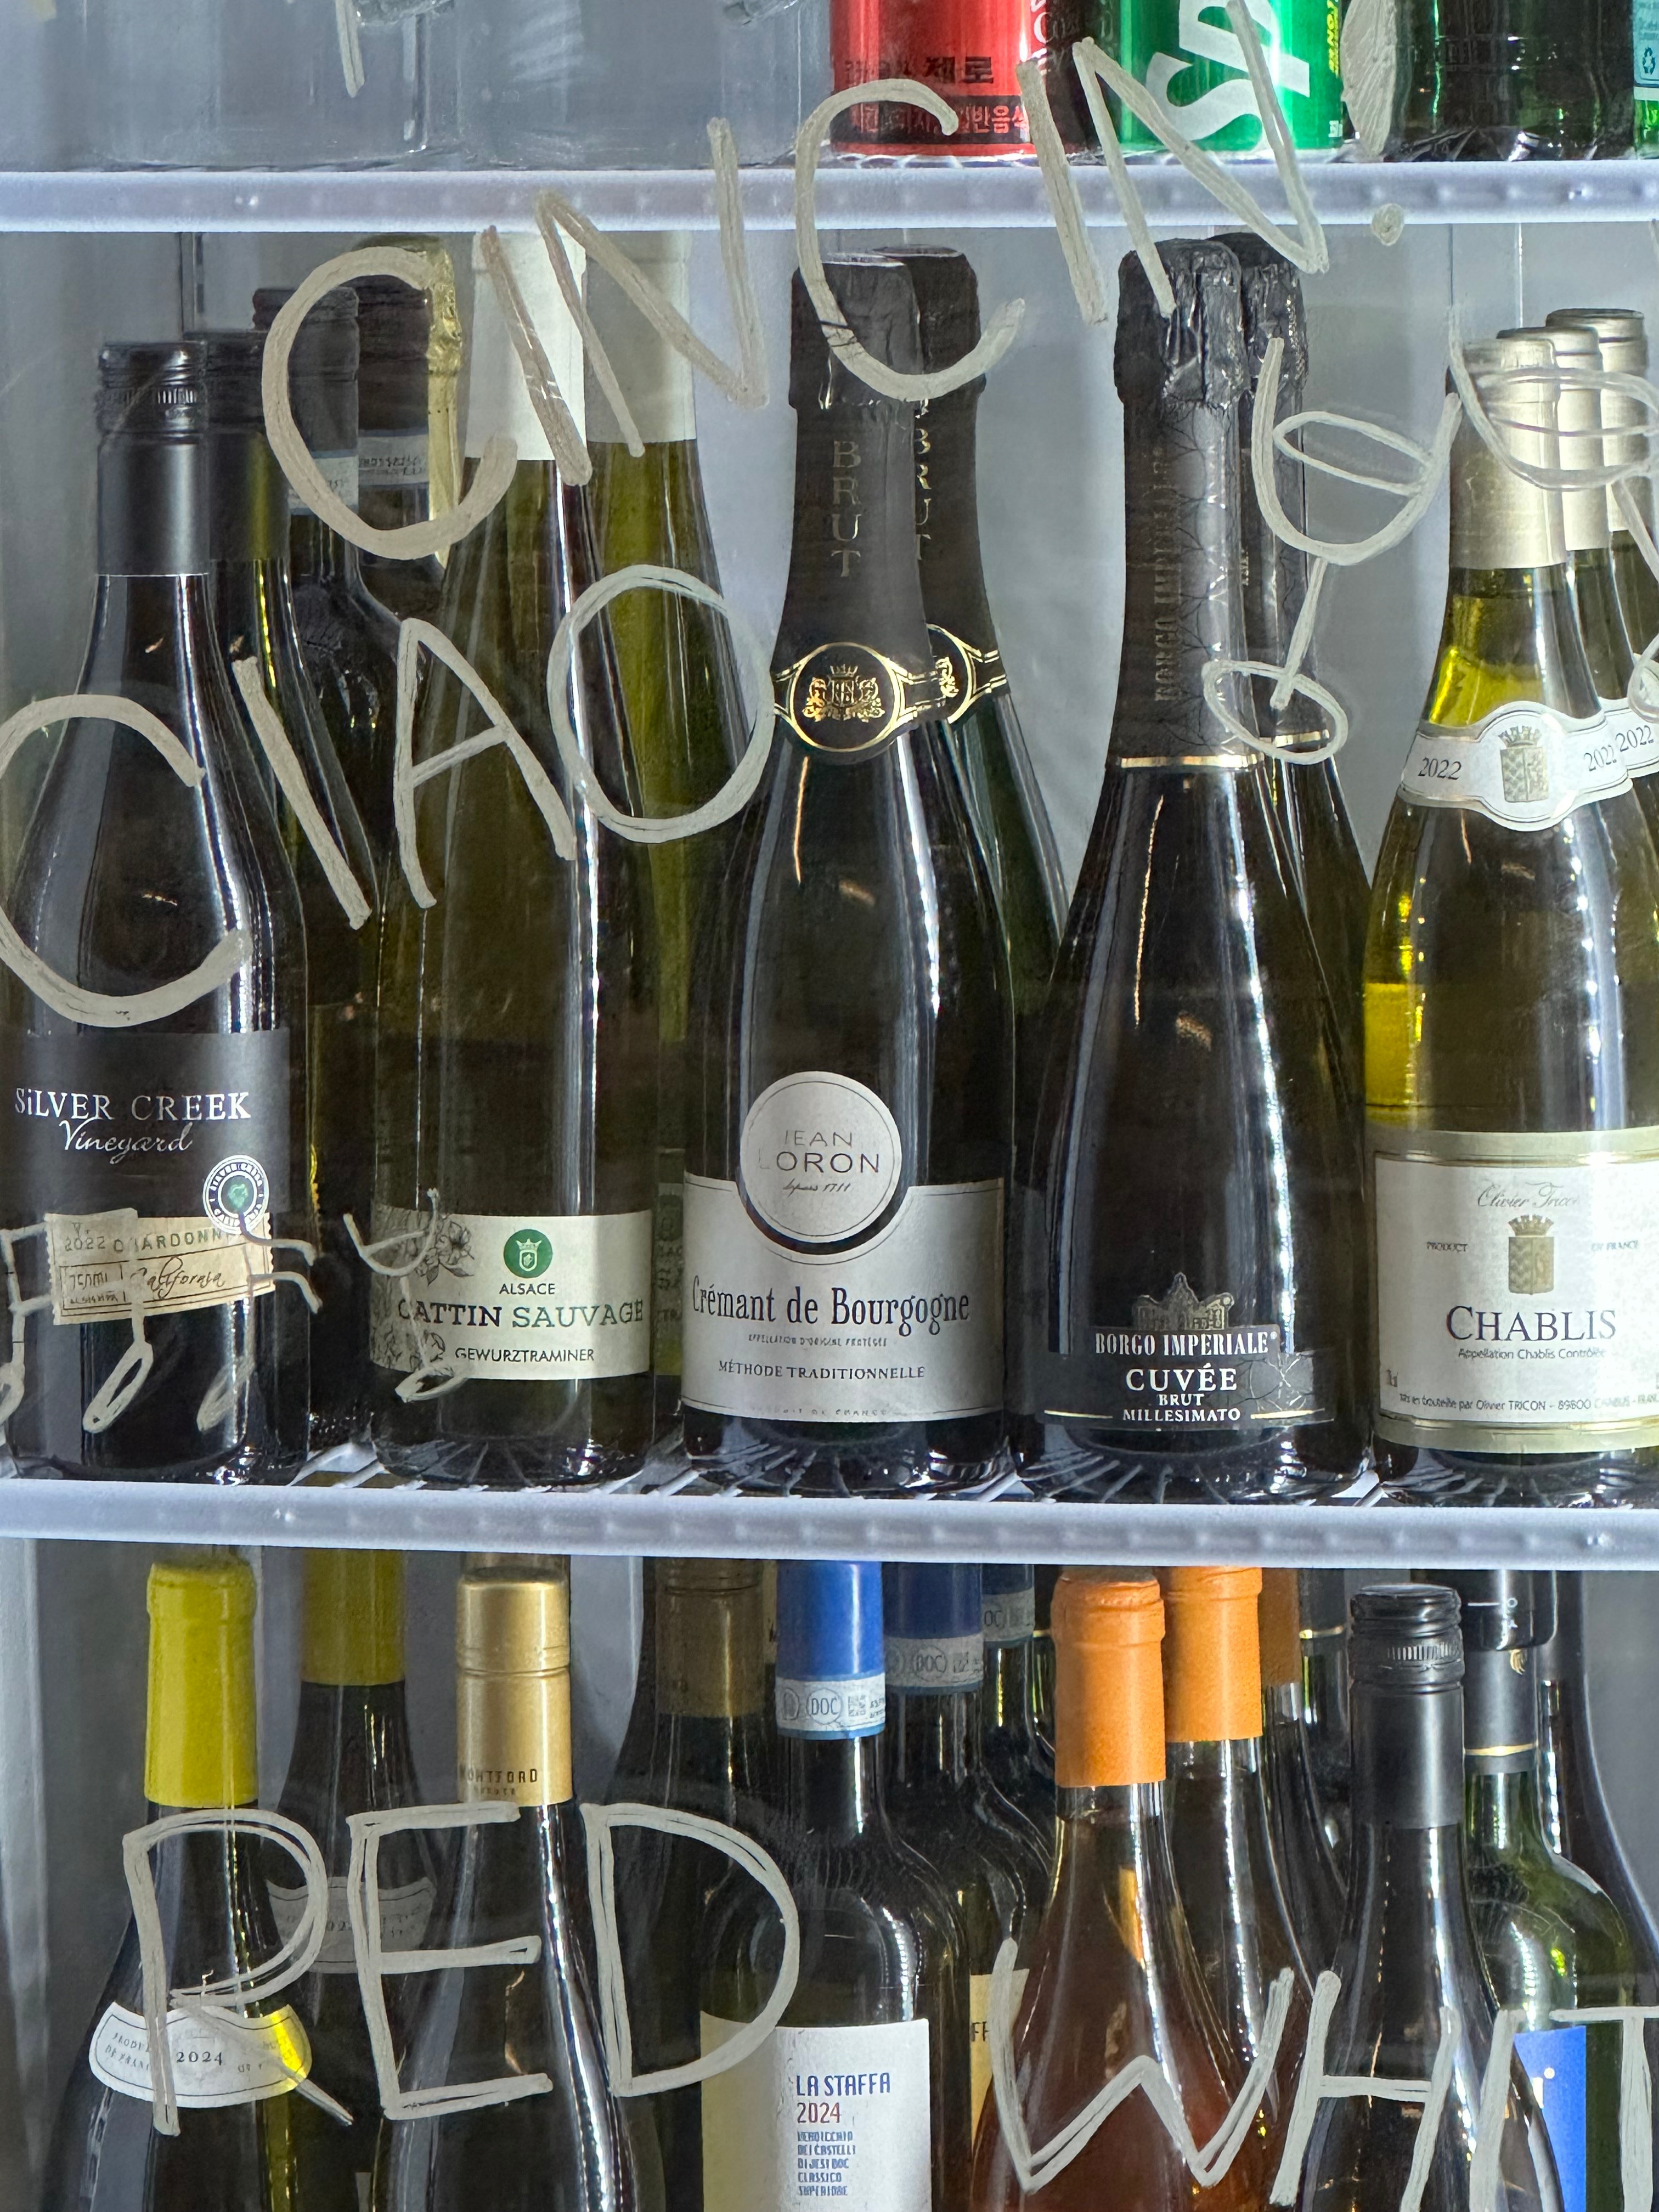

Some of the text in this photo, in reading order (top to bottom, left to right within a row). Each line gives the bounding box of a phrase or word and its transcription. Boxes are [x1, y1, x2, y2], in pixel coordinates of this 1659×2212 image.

[831, 441, 862, 577] BRUT
[1615, 725, 1654, 752] 2022
[1418, 757, 1462, 780] 2022
[0, 564, 779, 1028] CIAO
[131, 1092, 251, 1121] CREEK
[59, 1117, 193, 1164] Vineyard
[758, 1150, 879, 1174] LORON
[499, 1283, 556, 1295] ALSACE
[398, 1298, 644, 1328] CATTIN SAUVAGE
[692, 1275, 970, 1337] Crémant de Bourgogne
[1446, 1305, 1616, 1342] CHABLIS
[455, 1347, 595, 1362] GEWURZTRAMINER
[1096, 1331, 1269, 1356] BORGO IMPERIALE
[1517, 1348, 1555, 1359] Chablis
[719, 1359, 926, 1380] MÉTHODE TRADITIONNELLE
[1126, 1363, 1238, 1392] CUVÉE
[1158, 1393, 1205, 1407] BRUT
[1122, 1408, 1241, 1423] MILLESIMATO
[811, 1697, 838, 1716] DOC
[123, 1802, 801, 2137] RED
[176, 2051, 223, 2066] 2024
[796, 2072, 890, 2096] LA STAFFA
[797, 2102, 842, 2123] 2024
